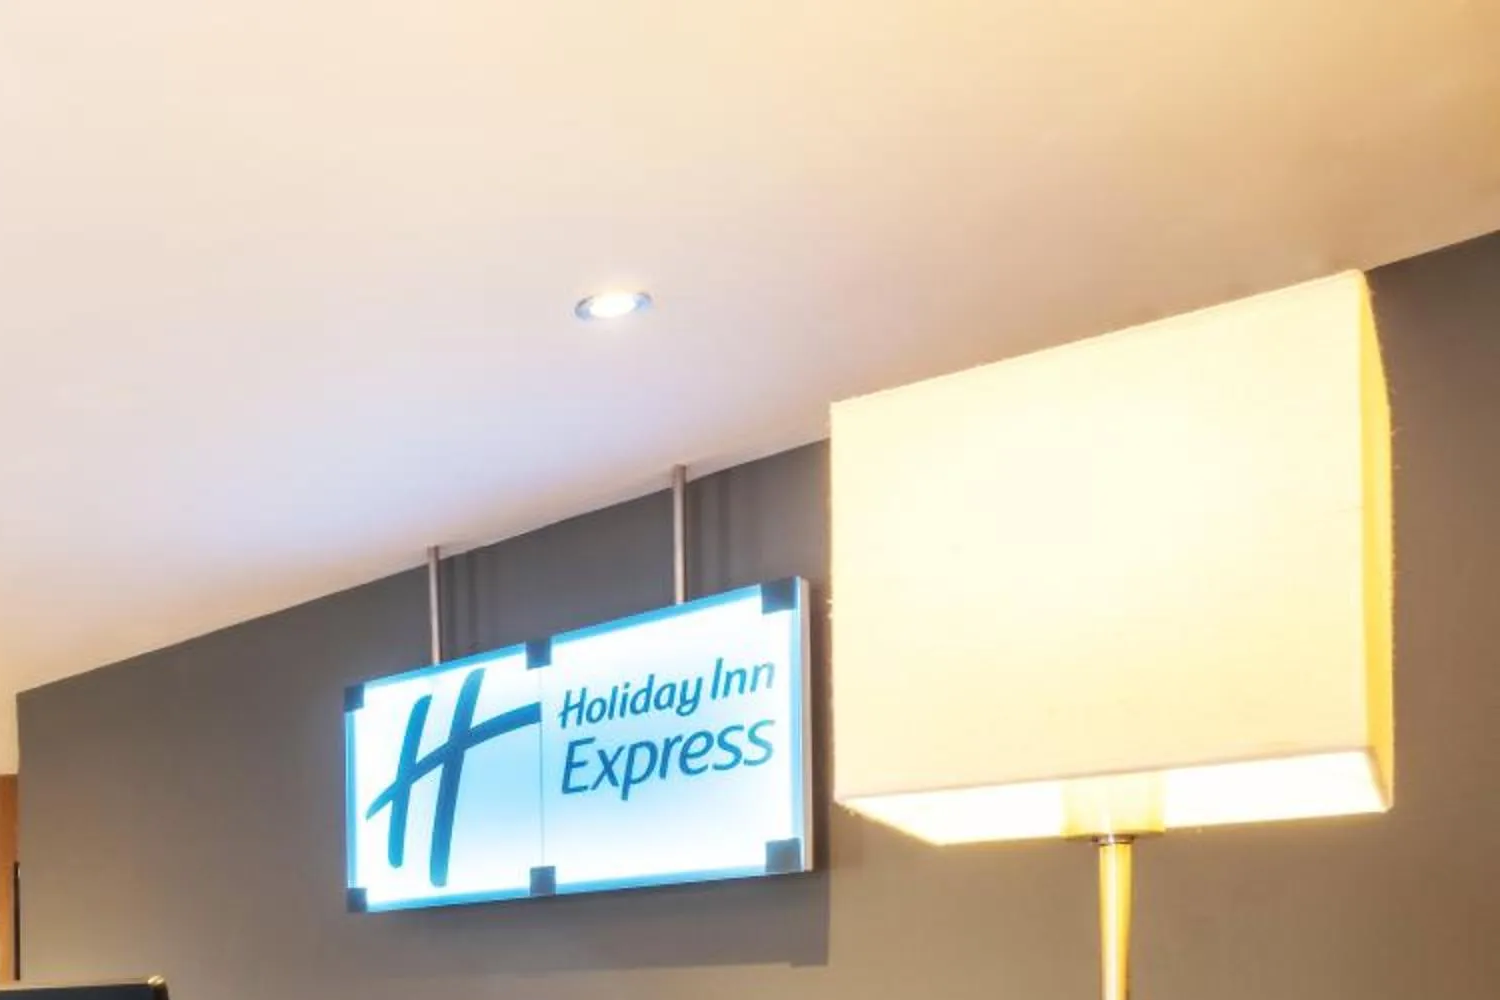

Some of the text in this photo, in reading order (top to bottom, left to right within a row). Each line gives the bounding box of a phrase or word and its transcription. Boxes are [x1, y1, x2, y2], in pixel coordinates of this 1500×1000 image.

[558, 656, 776, 730] Holiday Inn
[560, 719, 777, 802] Express
